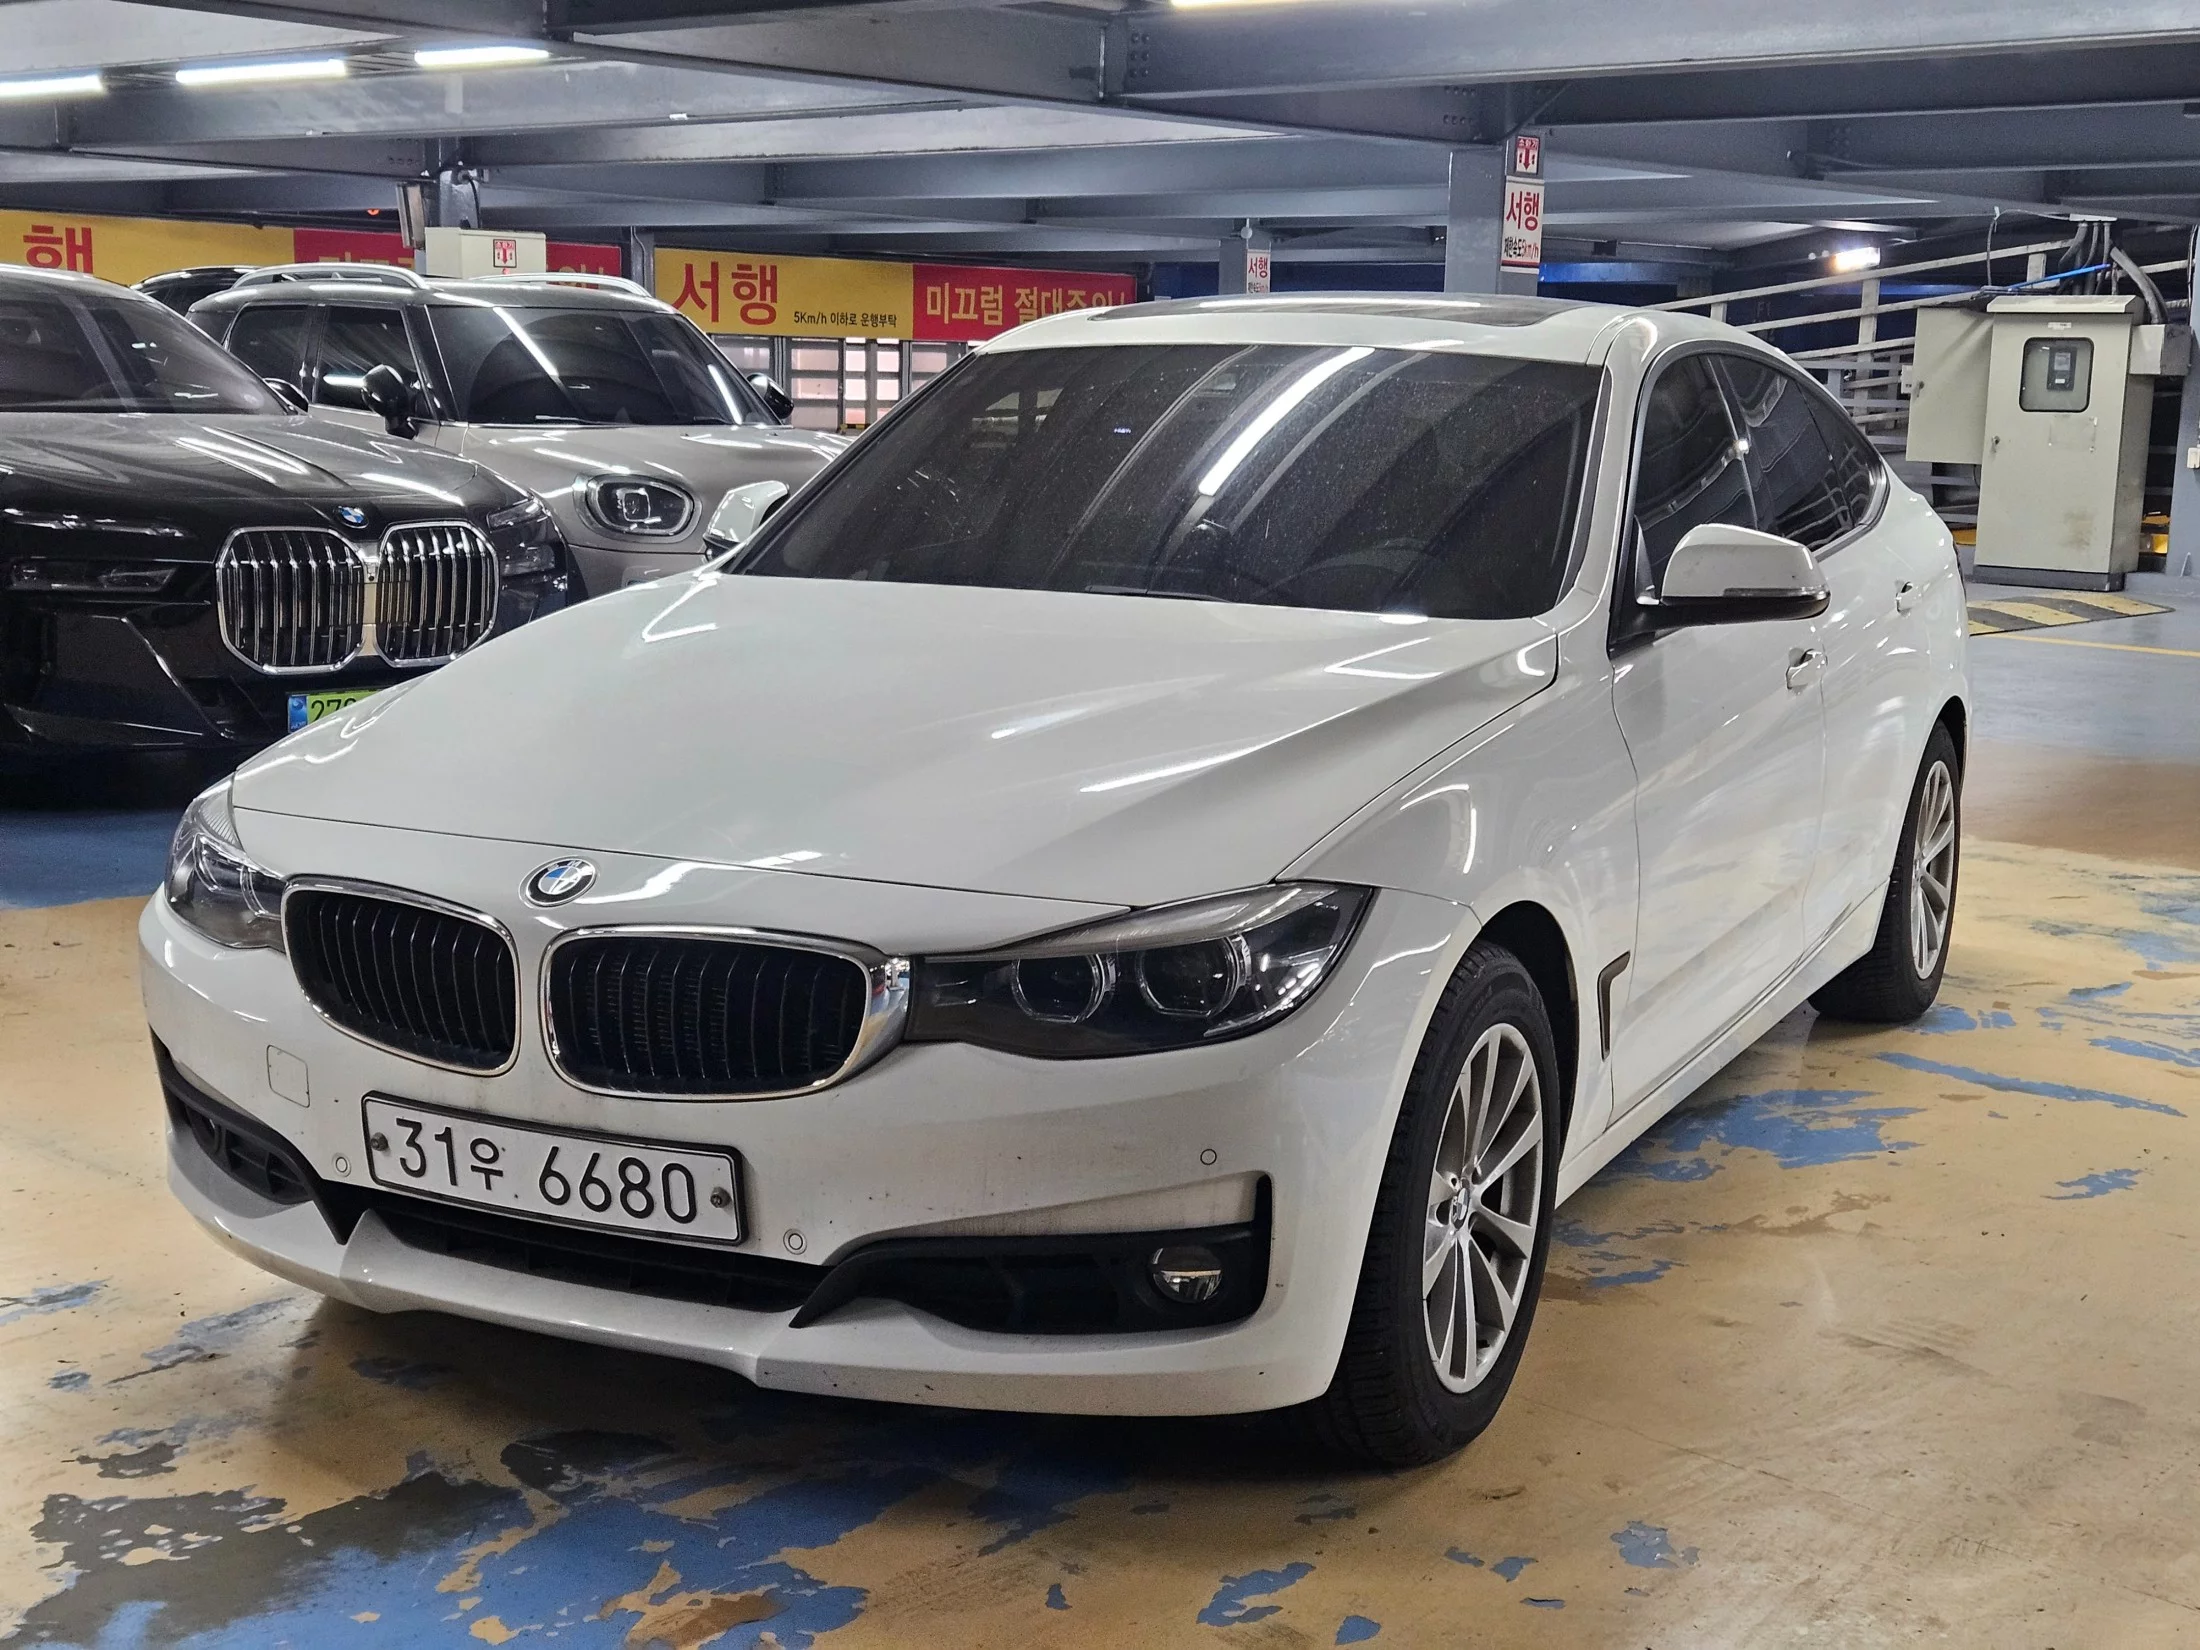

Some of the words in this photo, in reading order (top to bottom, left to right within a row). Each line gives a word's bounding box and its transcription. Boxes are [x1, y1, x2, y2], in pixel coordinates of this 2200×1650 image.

[1506, 190, 1540, 232] 서행
[1249, 257, 1268, 278] 서행
[673, 261, 778, 326] 서행
[926, 282, 1003, 326] 미끄럼
[794, 311, 827, 325] 5Km/h
[830, 312, 857, 326] 이하로
[861, 313, 897, 328] 운행부탁
[396, 1117, 504, 1191] 31우
[538, 1145, 698, 1225] 6680
